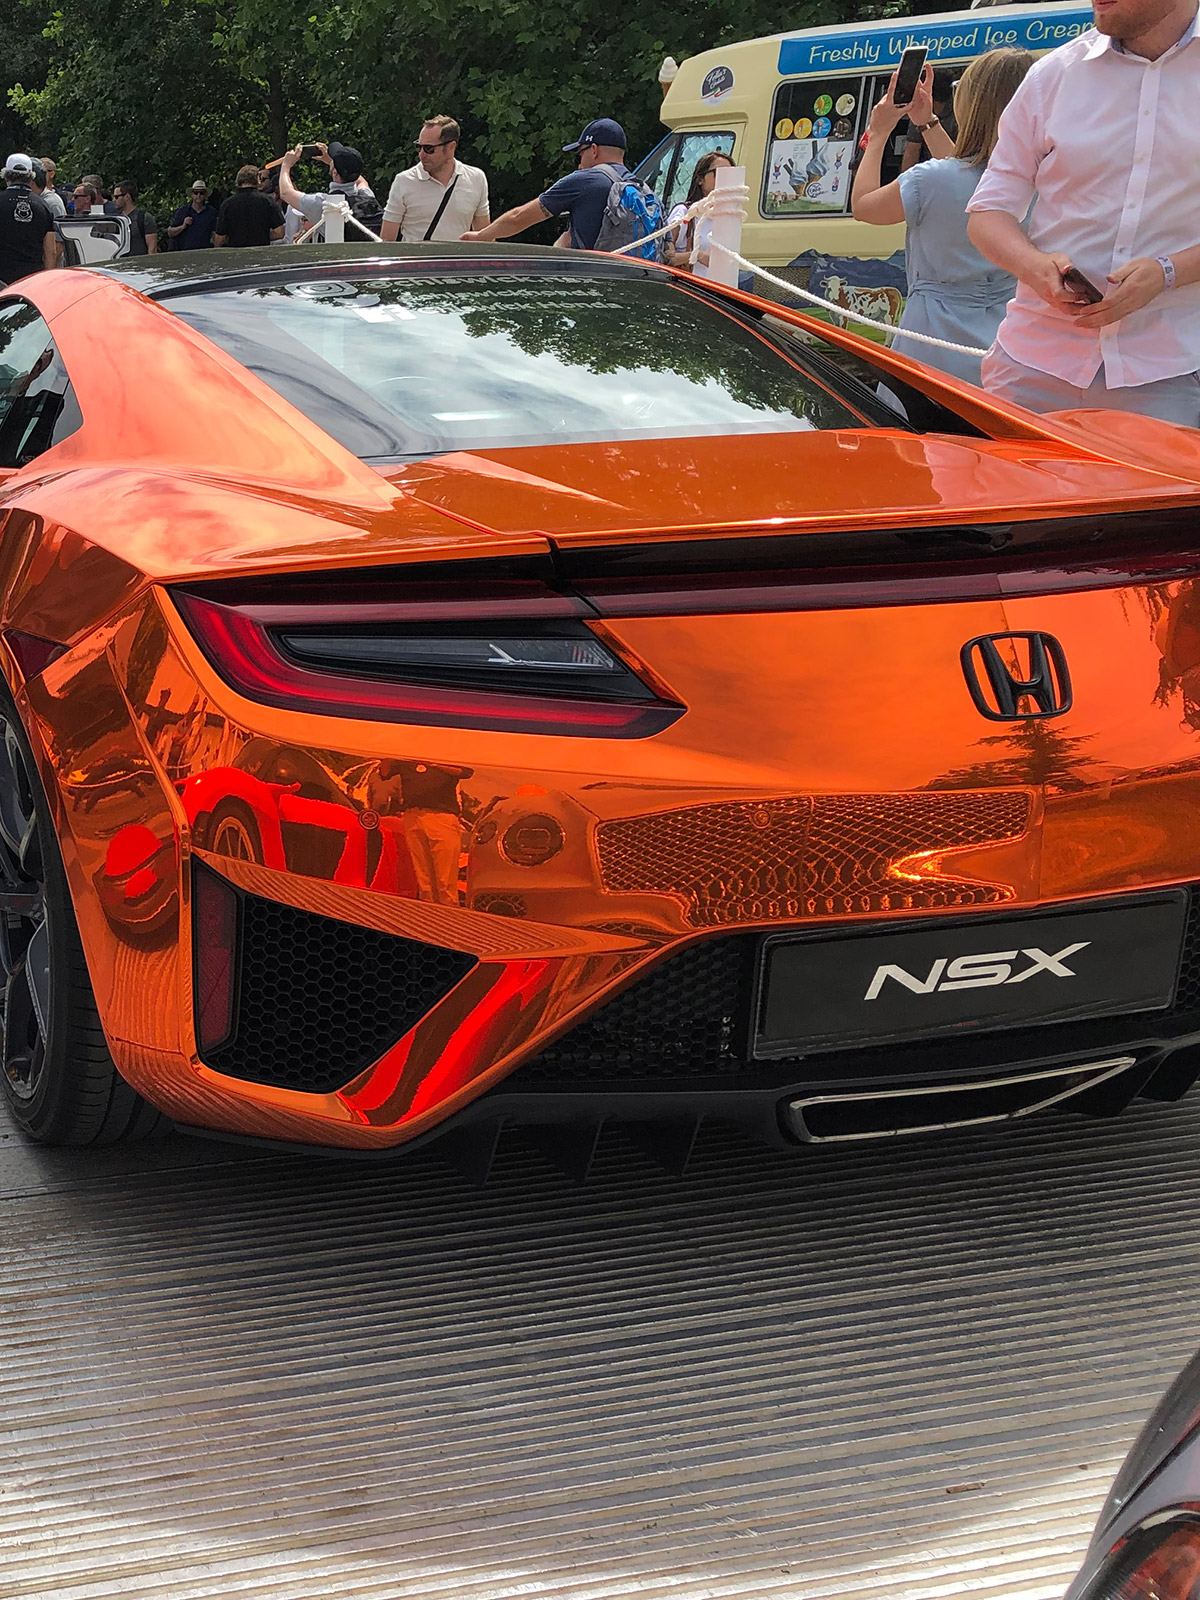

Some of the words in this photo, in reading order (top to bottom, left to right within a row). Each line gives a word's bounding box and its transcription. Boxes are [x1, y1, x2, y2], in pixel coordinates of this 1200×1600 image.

[809, 40, 881, 64] Freshly
[889, 28, 979, 57] Whipped
[985, 26, 1018, 45] Ice
[536, 301, 624, 311] Honda
[864, 941, 1092, 1001] NSX
